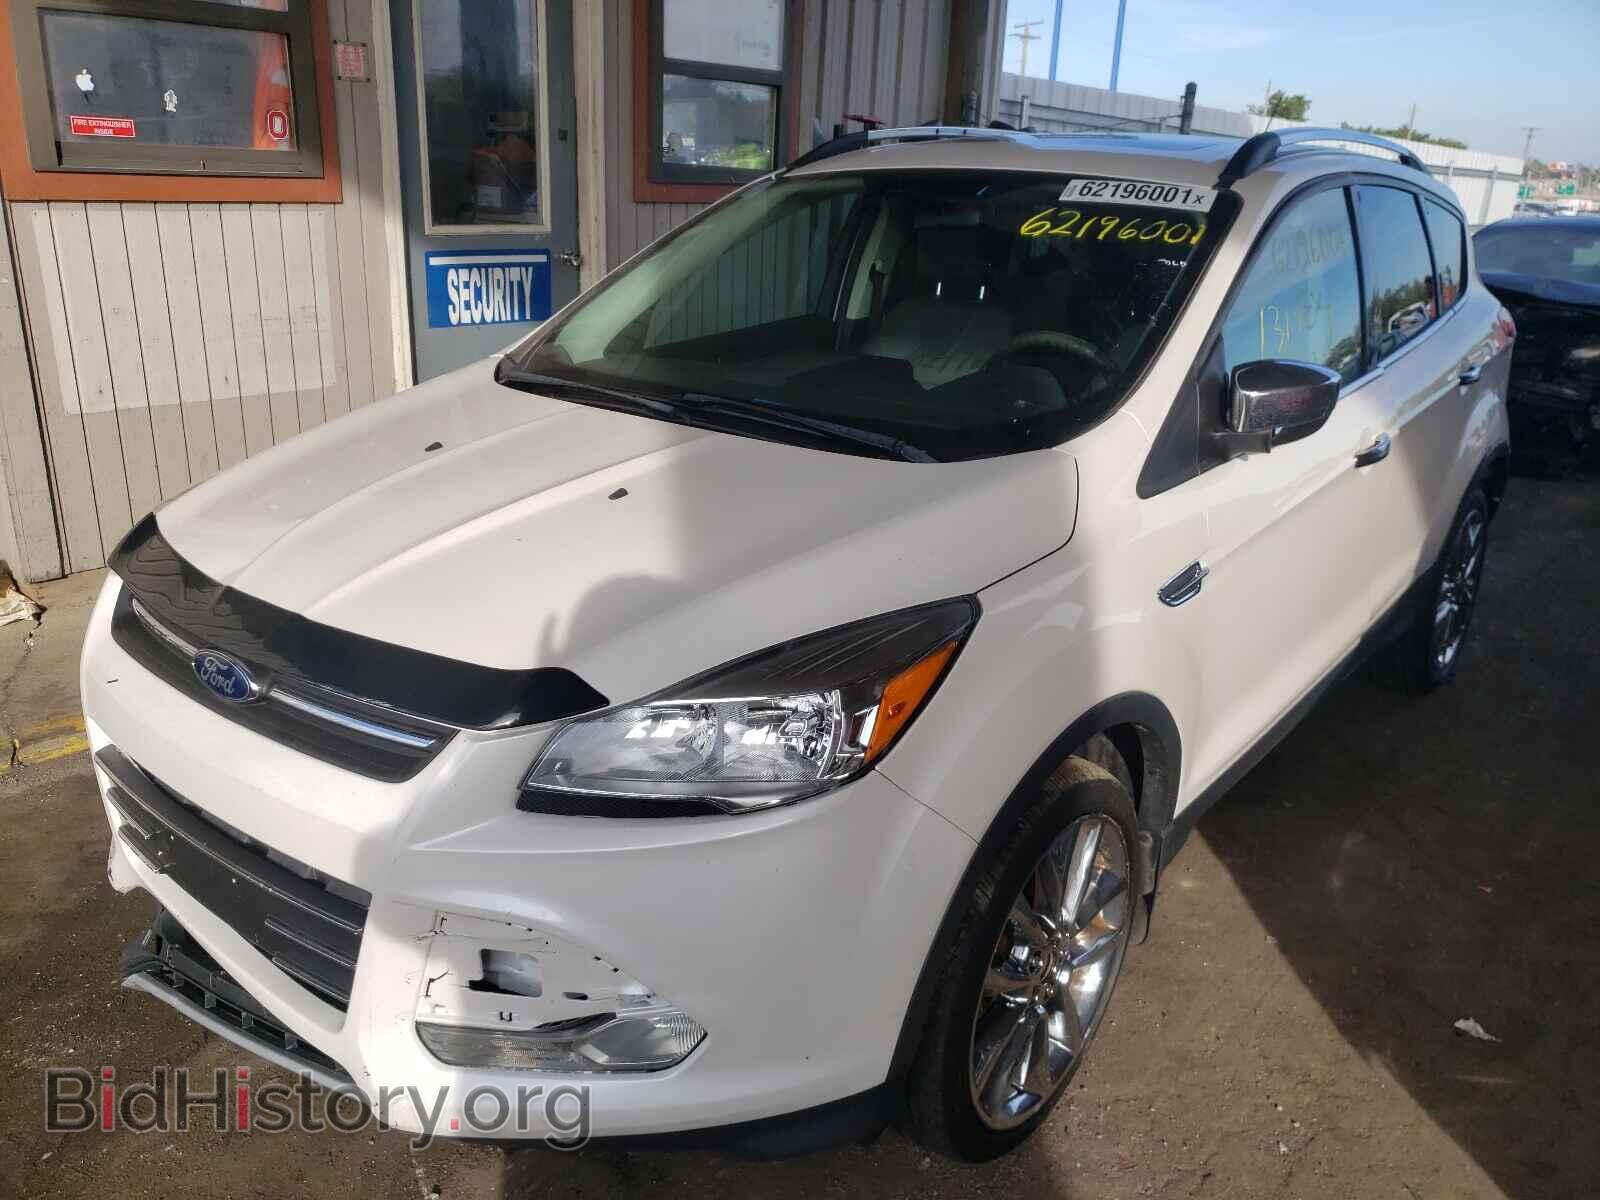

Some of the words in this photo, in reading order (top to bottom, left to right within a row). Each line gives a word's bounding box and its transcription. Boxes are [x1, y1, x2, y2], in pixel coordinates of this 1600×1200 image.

[73, 118, 88, 126] FIRE
[88, 119, 132, 129] EXTINGUISHER
[1020, 207, 1206, 245] 62196001
[447, 266, 533, 325] SECURITY
[200, 656, 237, 694] Ford
